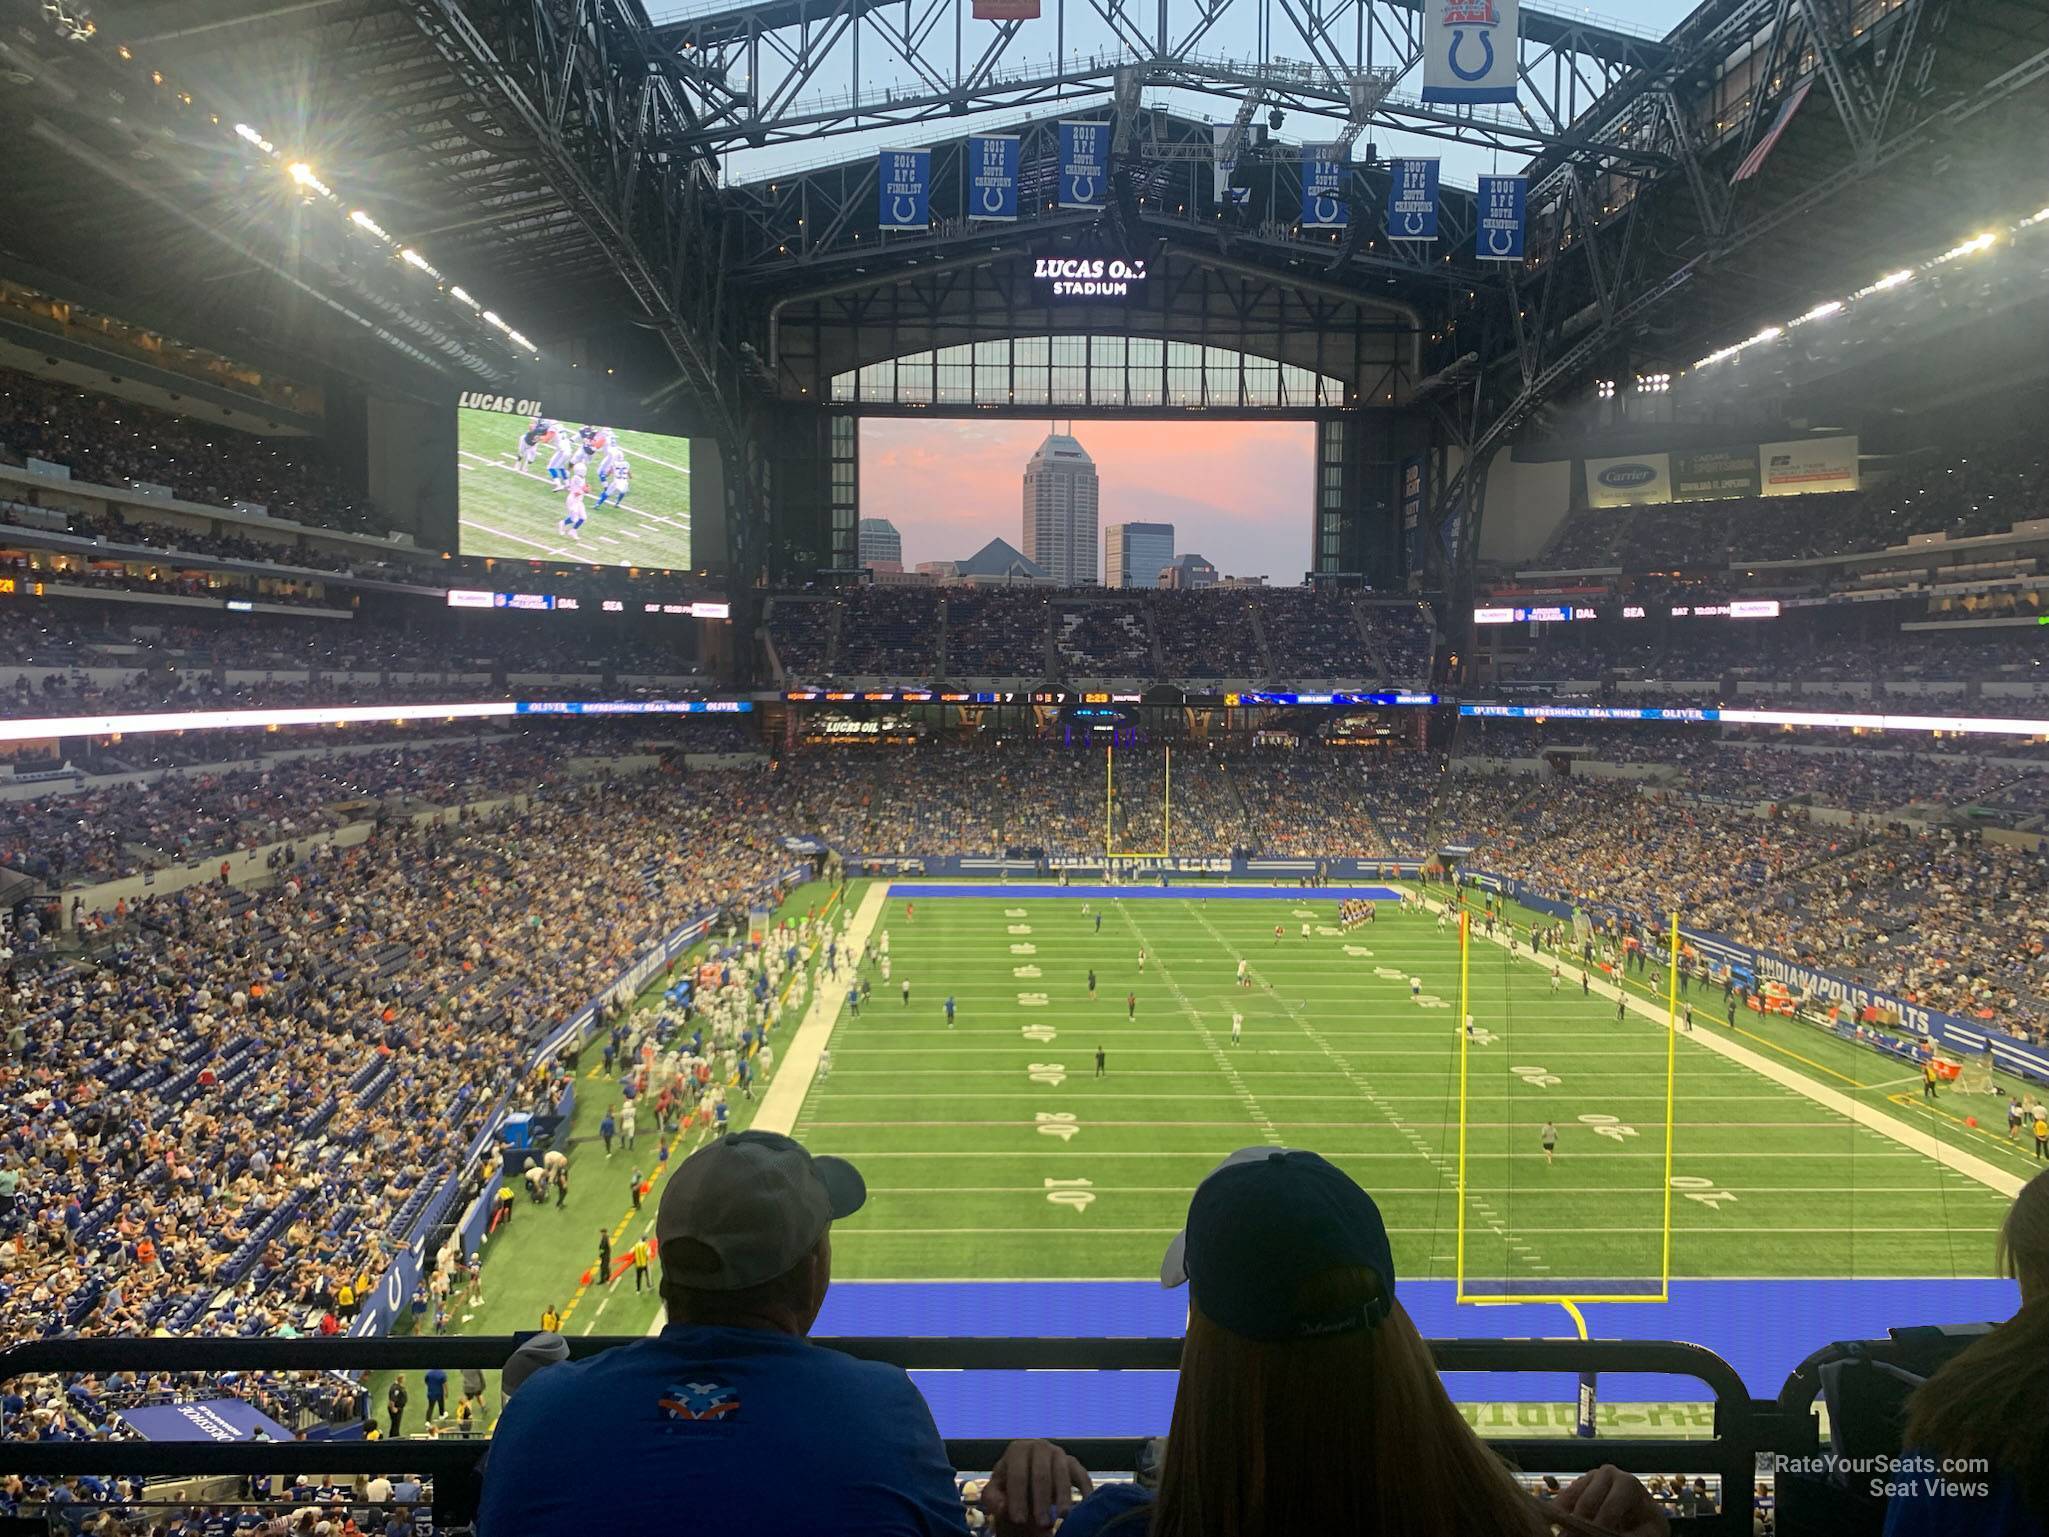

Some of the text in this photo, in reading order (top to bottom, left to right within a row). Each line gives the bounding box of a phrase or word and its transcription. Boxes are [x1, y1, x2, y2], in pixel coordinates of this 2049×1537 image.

[1073, 127, 1095, 139] 2010
[1073, 141, 1094, 153] AFC
[894, 155, 916, 168] 2014
[984, 153, 1005, 165] AFC
[1073, 154, 1093, 165] SOUTH
[983, 166, 1003, 176] SOUTH
[1065, 166, 1101, 177] CHAMPIONS
[1315, 161, 1339, 174] AFC
[1403, 161, 1426, 173] 2007
[894, 169, 916, 182] AFC
[1403, 173, 1425, 188] AFC
[975, 177, 1011, 188] CHAMPIONS
[887, 183, 922, 194] FINALIST
[1403, 189, 1425, 200] SOUTH
[1490, 195, 1513, 207] AFC
[1394, 201, 1432, 213] CHAMPIONS
[1490, 208, 1512, 218] SOUTH
[1034, 259, 1105, 278] LUCAS
[1053, 282, 1127, 295] STADIUM
[459, 391, 543, 417] LUCAS OIL
[1606, 470, 1649, 482] Carrier
[602, 600, 623, 611] SEA
[1576, 609, 1597, 618] DAL
[1623, 607, 1645, 617] SEA
[1671, 607, 1689, 616] SAT
[1005, 693, 1013, 702] 7
[1057, 693, 1065, 703] 7
[1473, 706, 1509, 715] OLIVER
[1524, 707, 1641, 718] REFRESHINGLY REAL WINES
[1662, 709, 1703, 718] OLIVER
[826, 722, 878, 733] LUCAS OIL
[1044, 1178, 1096, 1205] 10
[1670, 1176, 1738, 1202] 10
[415, 1522, 434, 1537] 53
